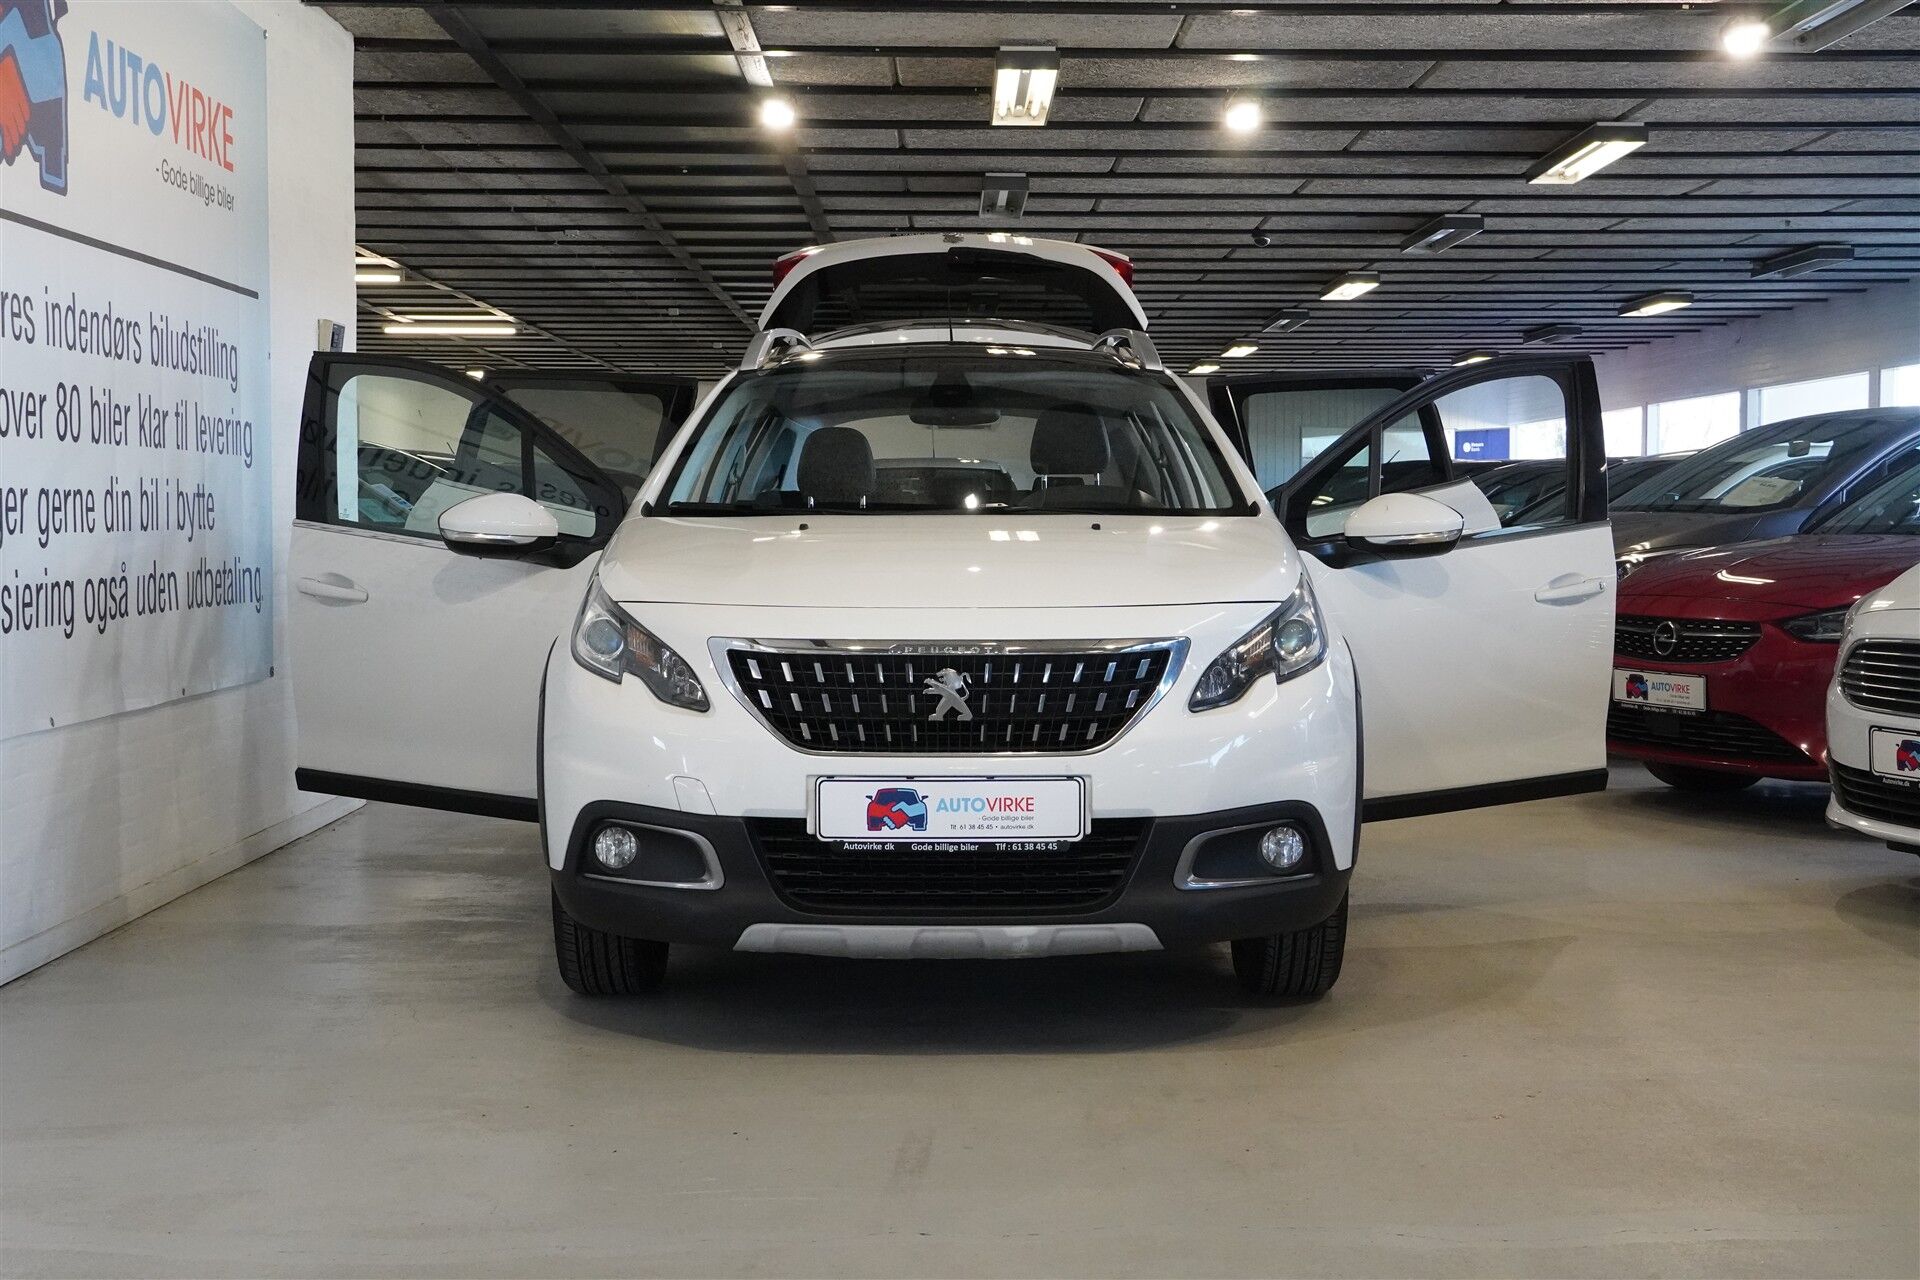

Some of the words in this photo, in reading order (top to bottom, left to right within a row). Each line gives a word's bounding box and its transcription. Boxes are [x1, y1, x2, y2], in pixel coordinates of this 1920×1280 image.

[83, 30, 234, 173] AUTOVIRKE
[162, 158, 188, 191] Gode
[190, 170, 215, 207] billige
[217, 184, 235, 212] biler
[45, 285, 142, 365] indendørs
[150, 311, 238, 394] biludstilling
[0, 387, 47, 439] over
[56, 381, 82, 443] 80
[90, 385, 131, 446] biler
[138, 392, 169, 450] klar
[175, 399, 188, 451] til
[195, 401, 253, 469] levering
[38, 487, 96, 549] gerne
[104, 475, 132, 533] din
[140, 476, 159, 532] bil
[166, 478, 170, 531] i
[177, 478, 216, 543] bytte
[1, 568, 75, 640] siering
[84, 561, 129, 635] også
[137, 559, 180, 616] uden
[1651, 681, 1691, 694] AUTOVIRKE
[936, 797, 1035, 812] AUTOVIRKE
[1001, 815, 1020, 823] billige
[911, 843, 933, 851] Gode
[934, 842, 959, 852] billige
[960, 842, 979, 851] biler
[1012, 842, 1023, 850] 61
[1024, 842, 1035, 850] 38
[1036, 842, 1046, 850] 45
[1047, 842, 1058, 850] 45
